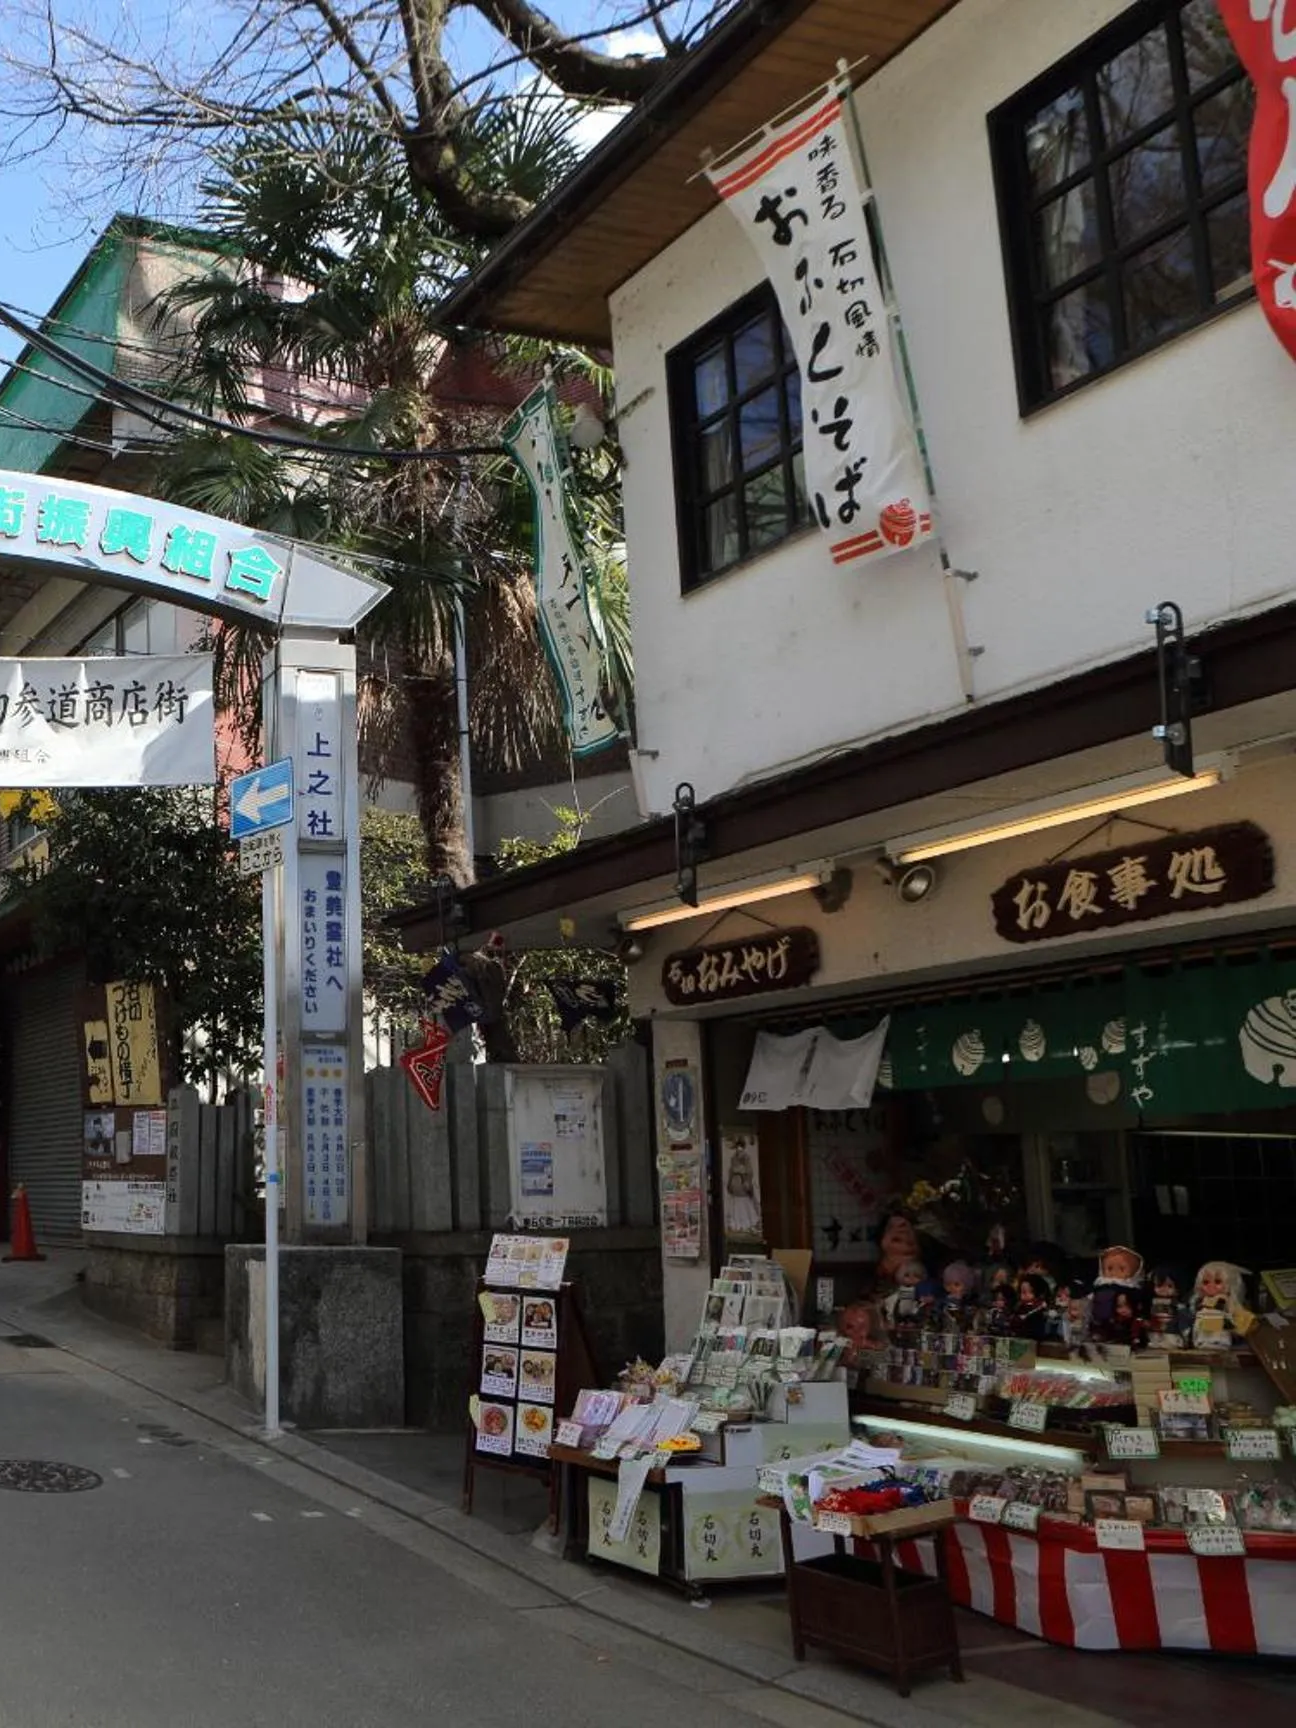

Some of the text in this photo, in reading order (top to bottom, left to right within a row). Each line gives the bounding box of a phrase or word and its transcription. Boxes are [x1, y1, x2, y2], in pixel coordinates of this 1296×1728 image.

[306, 732, 334, 836] 上之社
[1012, 846, 1226, 931] お食事処
[304, 888, 318, 1014] おまいりください
